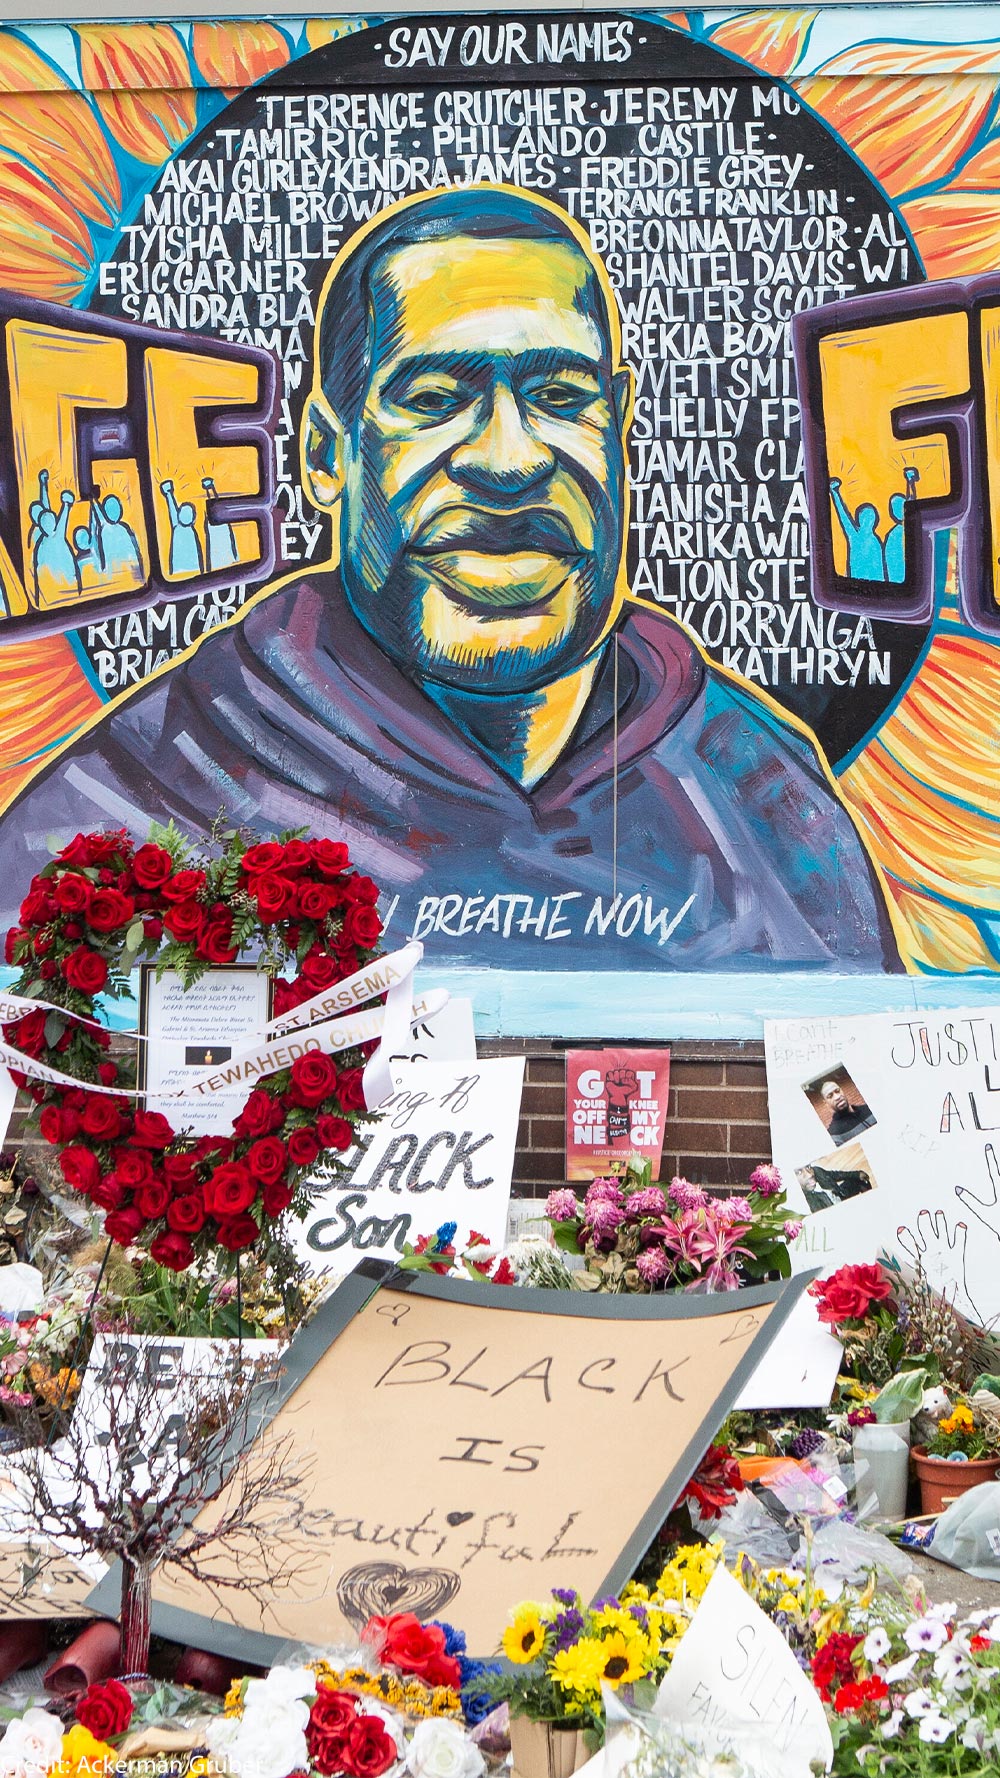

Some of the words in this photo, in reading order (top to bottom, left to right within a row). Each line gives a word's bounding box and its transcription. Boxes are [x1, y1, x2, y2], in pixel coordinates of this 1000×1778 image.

[384, 25, 454, 68] SAY
[460, 25, 533, 66] OUR
[256, 92, 424, 130] TERRENCE
[434, 87, 587, 127] CRUTCHER
[602, 87, 738, 125] JEREMY
[215, 129, 319, 161] TAMIR
[321, 128, 402, 160] RICE
[433, 123, 607, 157] PHILANDO
[638, 122, 765, 158] CASTILE
[157, 159, 225, 194] AKAI
[231, 158, 332, 193] GURLEY
[334, 156, 452, 191] KENDRA
[449, 154, 557, 188] JAMES
[580, 155, 711, 190] FREDDIE
[718, 153, 805, 189] GREY
[144, 191, 280, 227] MICHAEL
[559, 187, 693, 219] TERRANCE
[699, 187, 838, 216] FRANKLIN
[120, 224, 231, 264] TYISHA
[590, 219, 728, 254] BREONNA
[728, 216, 849, 252] TAYLOR
[861, 213, 906, 248] AL
[99, 261, 171, 296] ERIC
[173, 260, 314, 295] GARNER
[606, 252, 749, 288] SHANTEL
[751, 250, 845, 287] DAVIS
[858, 248, 908, 283] WI
[121, 294, 249, 329] SANDRA
[258, 293, 316, 327] BLA
[614, 286, 748, 323] WALTER
[622, 322, 715, 360] REKIA
[628, 358, 727, 398] YVETT
[728, 357, 791, 400] SMI
[632, 397, 748, 439] SHELLY
[626, 440, 746, 484] JAMAR
[629, 483, 774, 524] TANISHA
[630, 523, 754, 560] TARIKA
[631, 559, 738, 602] ALTON
[746, 558, 807, 601] STE
[722, 647, 891, 687] KATHRYN
[406, 889, 583, 942] BREATHE
[584, 891, 698, 945] NOW
[308, 965, 402, 1021] ARSEMA
[192, 1037, 321, 1095] TEWAHEDO
[377, 1077, 435, 1129] ing
[572, 1109, 606, 1125] OFF
[632, 1110, 661, 1126] MY
[573, 1099, 606, 1109] YOUR
[629, 1100, 659, 1110] KNEE
[573, 1125, 607, 1145] NE
[630, 1126, 661, 1146] CK
[307, 1193, 412, 1251] Son
[795, 1223, 835, 1253] ALL
[373, 1339, 691, 1403] BLACK
[439, 1437, 546, 1473] IS
